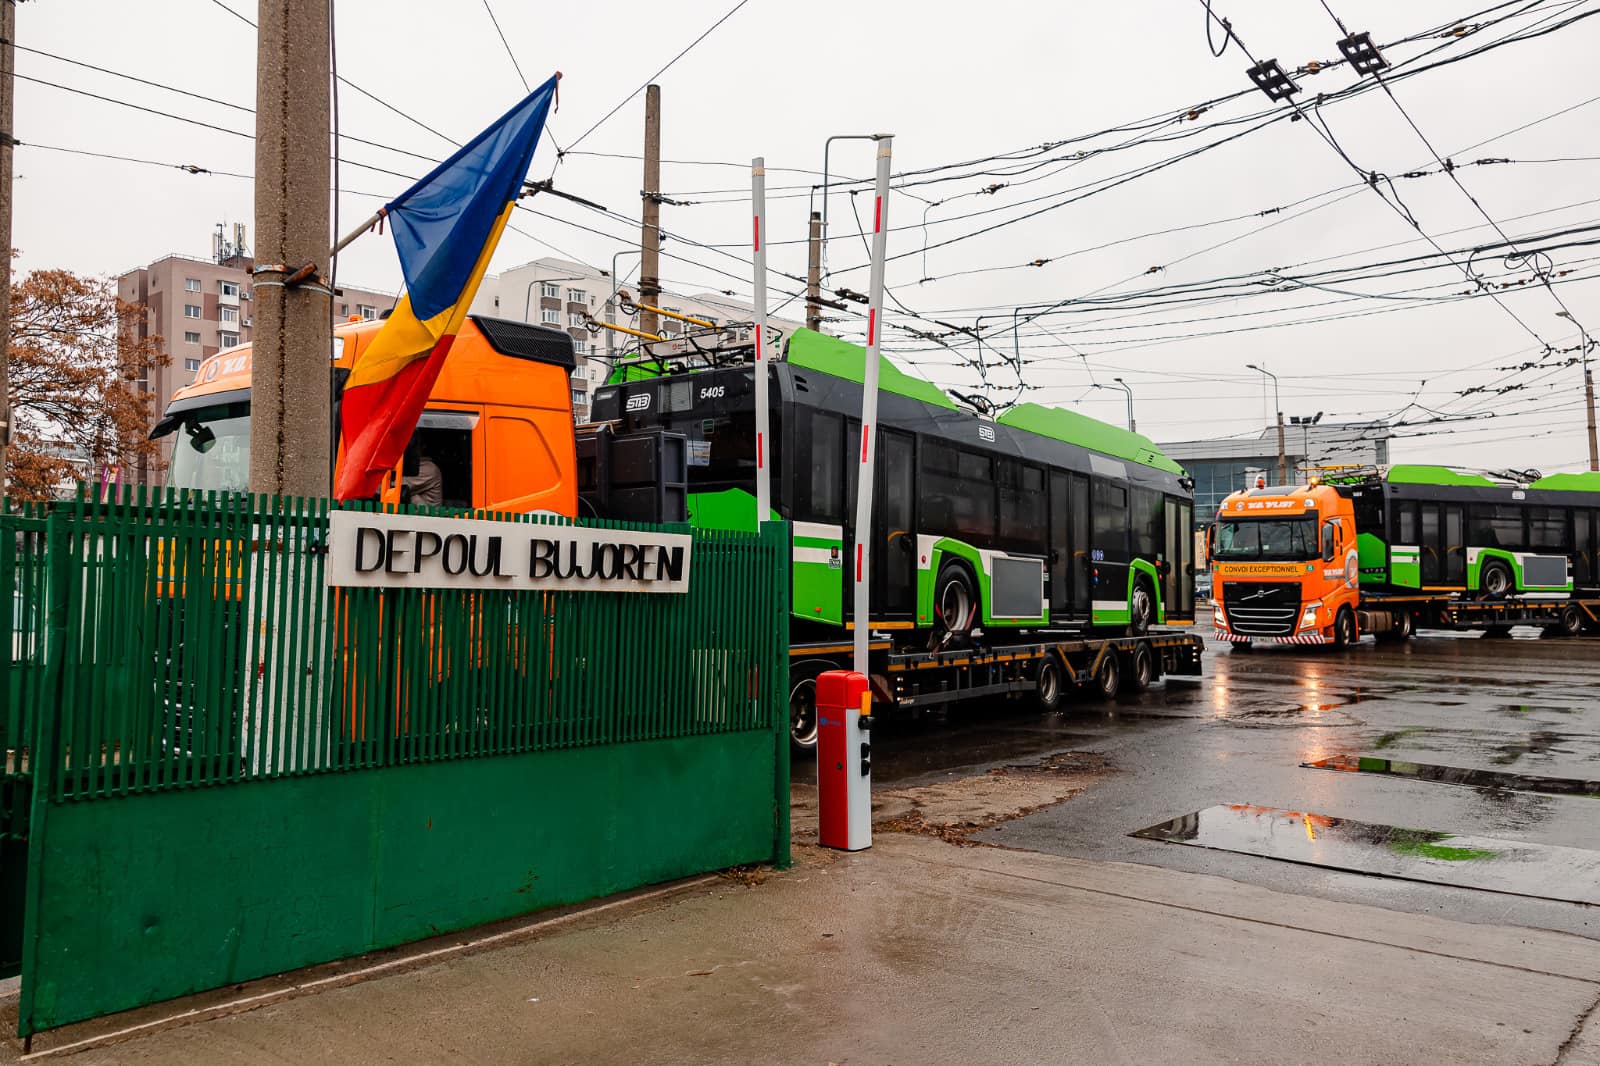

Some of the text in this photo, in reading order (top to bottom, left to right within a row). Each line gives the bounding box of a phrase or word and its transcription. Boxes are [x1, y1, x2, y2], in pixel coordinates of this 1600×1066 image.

[700, 386, 725, 399] 5405
[625, 395, 650, 410] STB
[355, 527, 518, 577] DEPOUL
